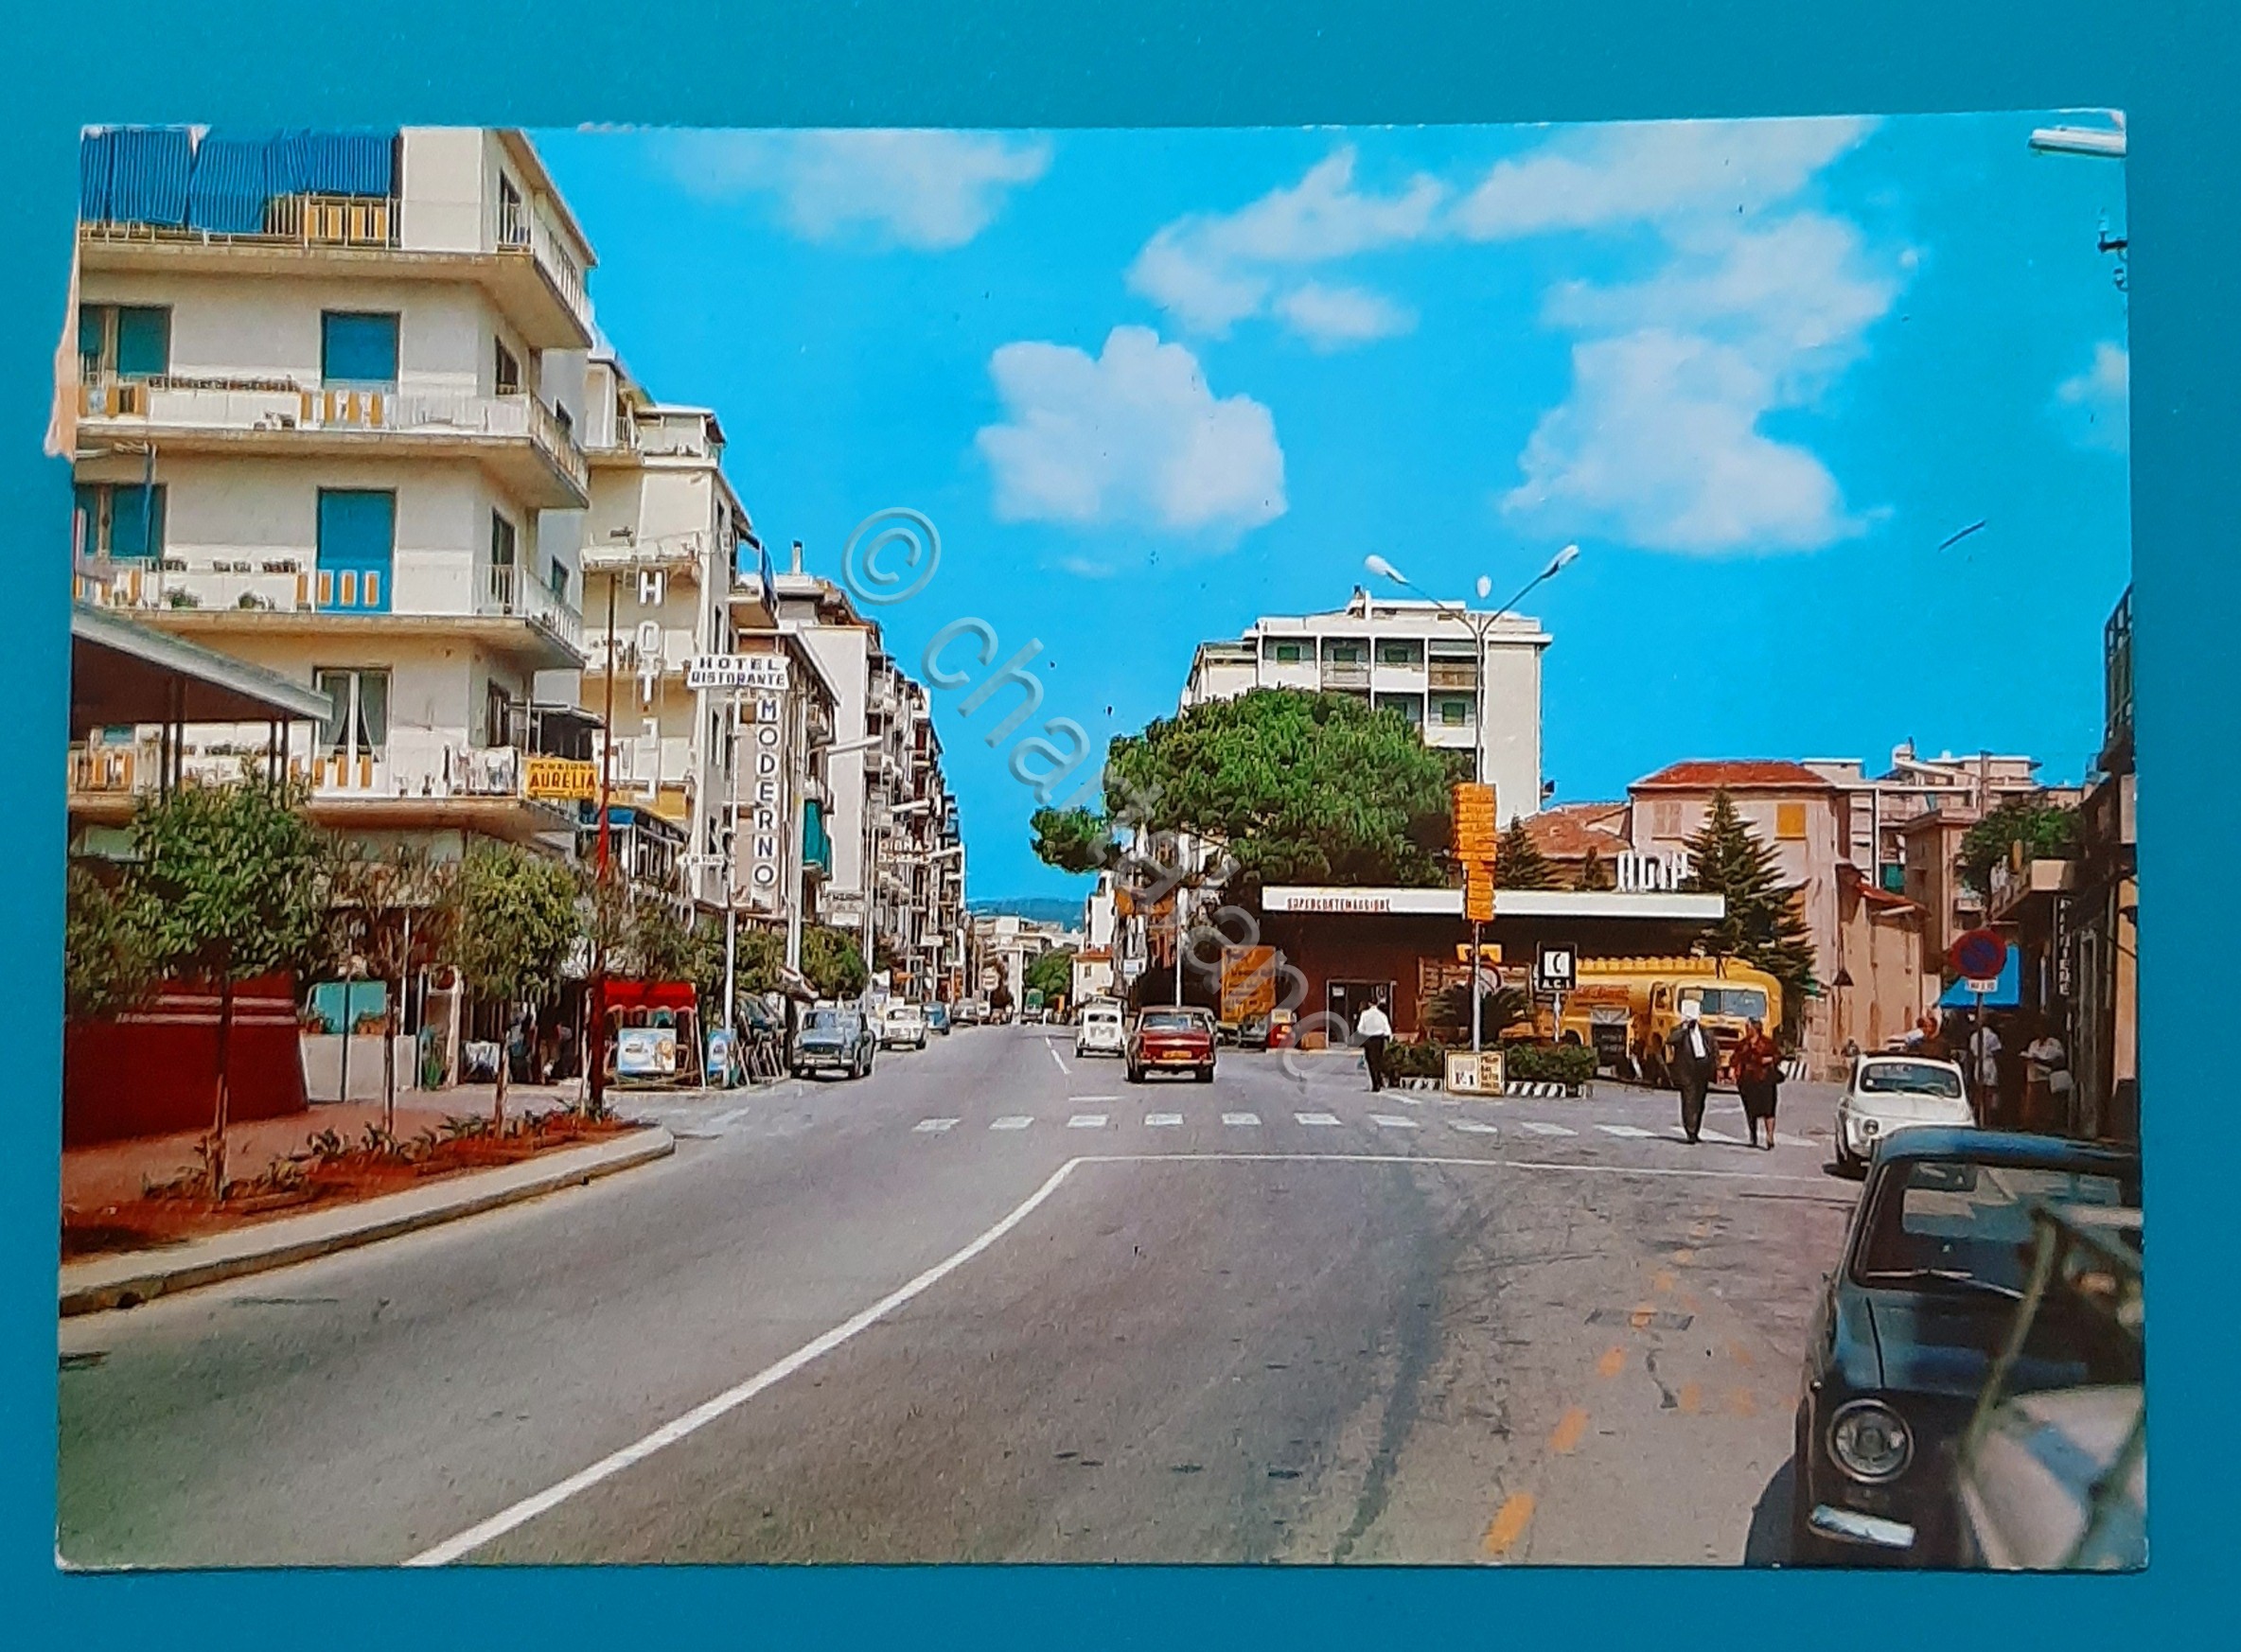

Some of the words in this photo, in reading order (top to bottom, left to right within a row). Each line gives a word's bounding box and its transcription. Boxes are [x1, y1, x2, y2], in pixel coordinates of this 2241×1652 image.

[699, 658, 780, 671] HOTEL
[692, 672, 785, 686] RISTORANTE
[530, 772, 595, 789] AURELIA
[754, 699, 778, 885] MODERNO
